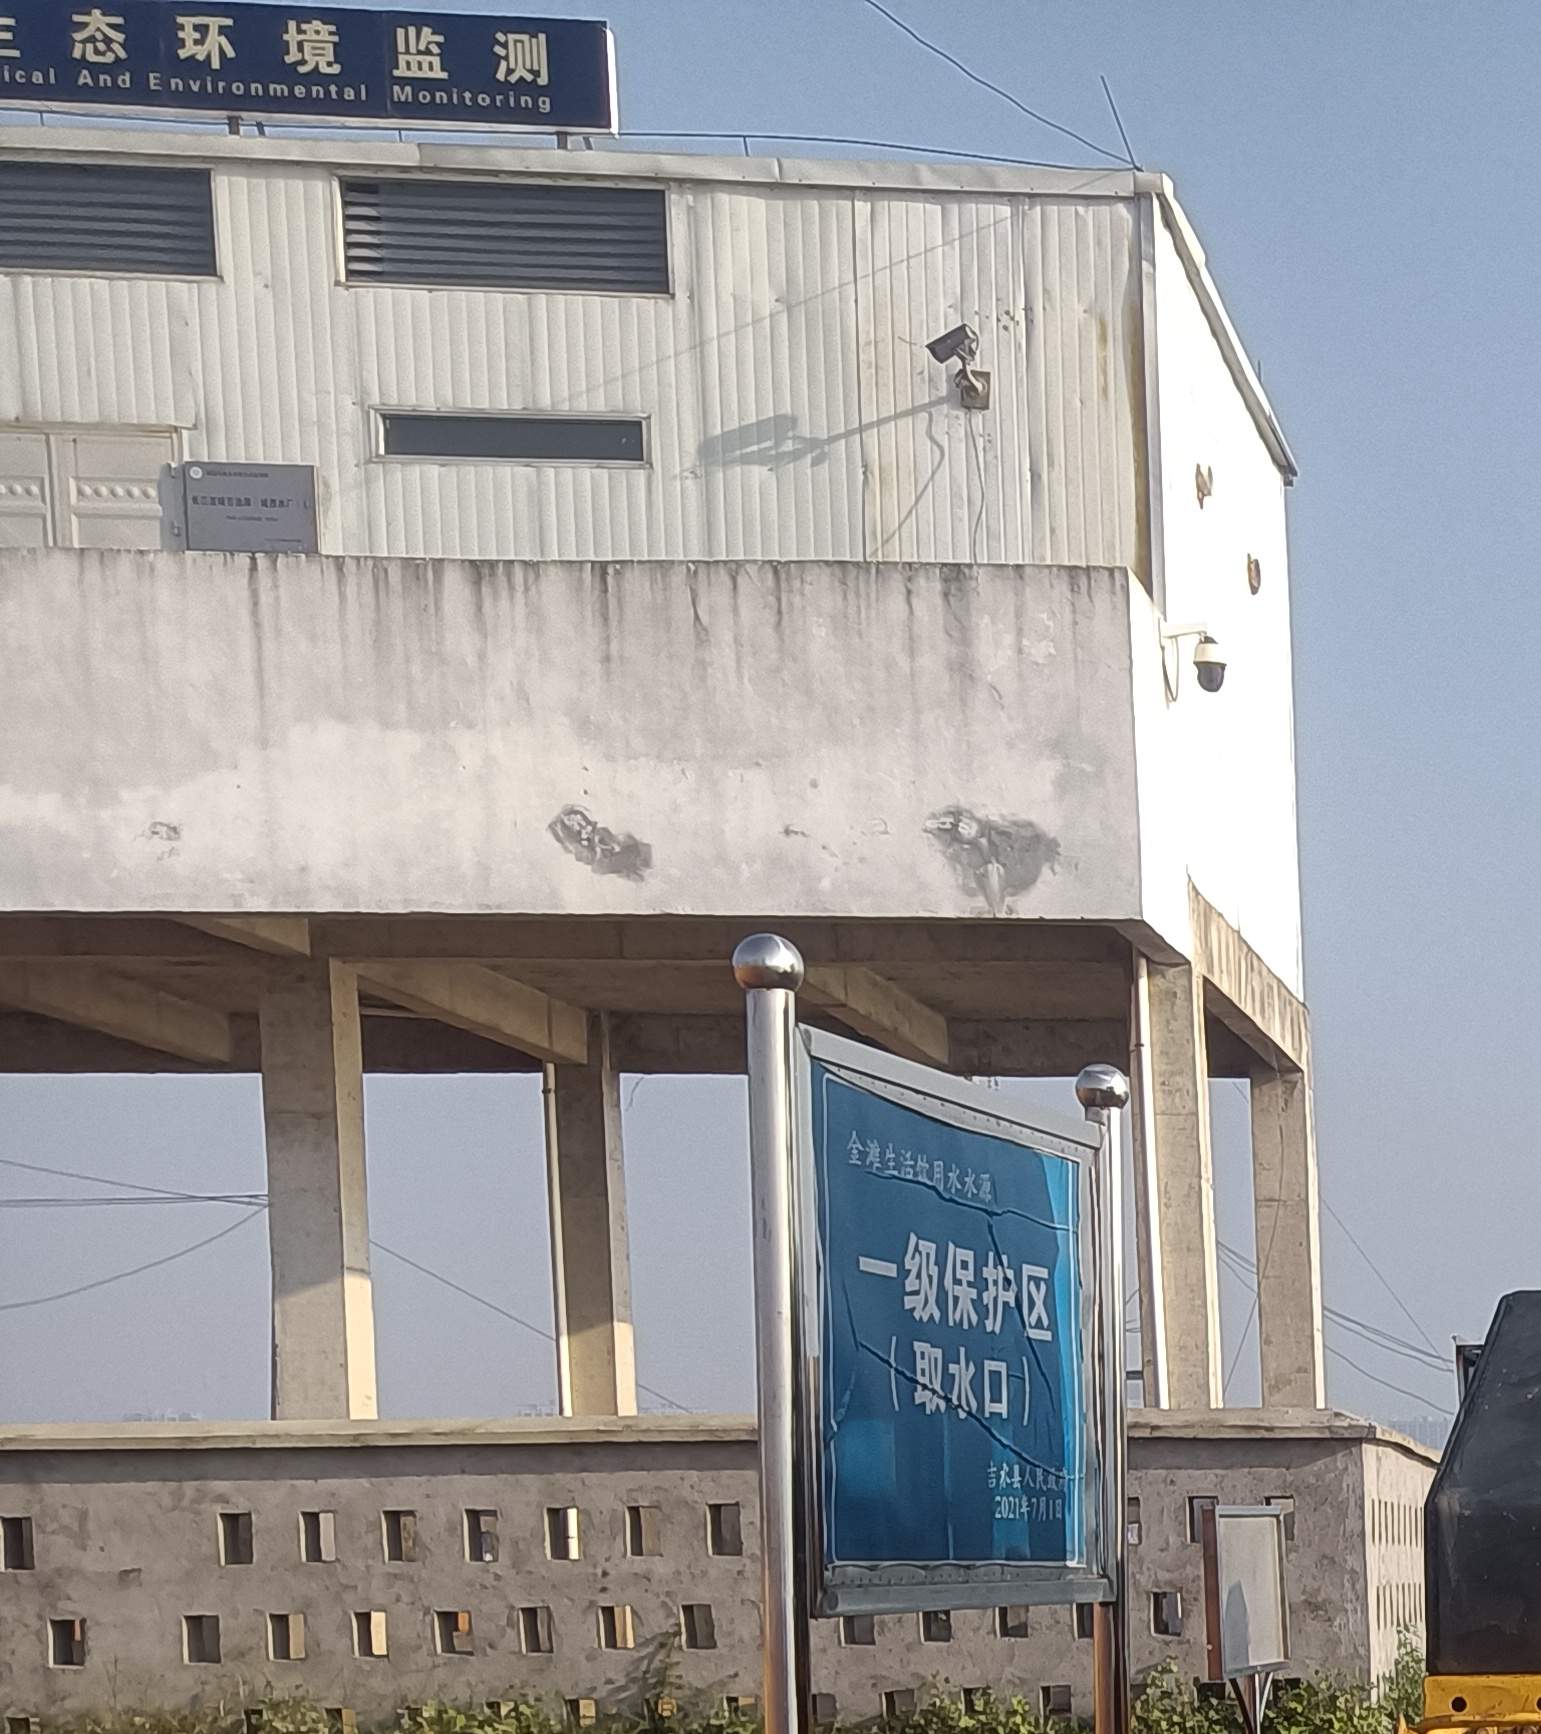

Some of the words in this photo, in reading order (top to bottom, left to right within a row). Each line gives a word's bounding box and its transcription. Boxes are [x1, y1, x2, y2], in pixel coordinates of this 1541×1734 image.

[3, 65, 56, 85] ical
[77, 69, 131, 89] And
[149, 72, 367, 101] Environmental
[393, 85, 552, 113] Monitoring
[858, 1231, 1052, 1342] 一级保护区
[994, 1494, 1062, 1521] 2021年7月1日
